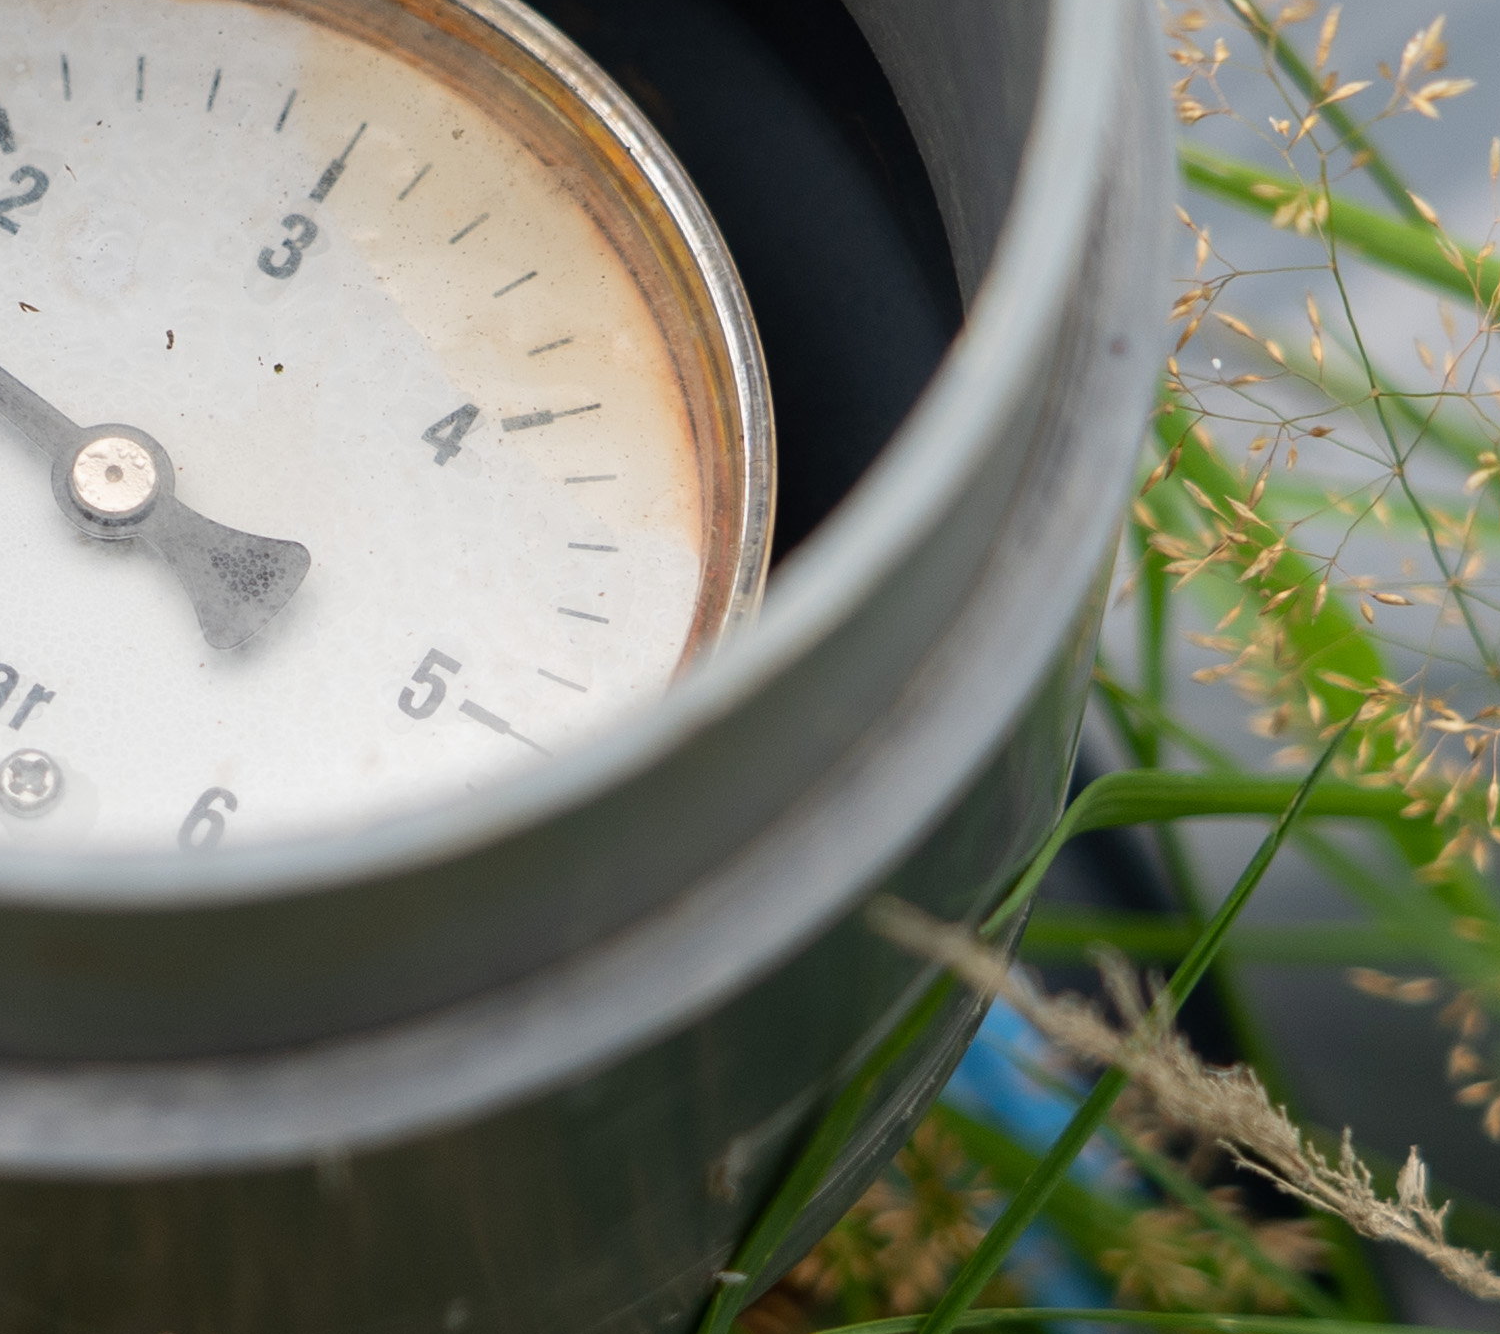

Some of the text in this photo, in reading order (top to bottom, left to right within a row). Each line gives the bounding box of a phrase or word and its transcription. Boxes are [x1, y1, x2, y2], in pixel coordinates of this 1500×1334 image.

[257, 211, 320, 281] 3
[421, 402, 482, 468] 4
[396, 646, 464, 721] 5
[176, 785, 239, 856] 6
